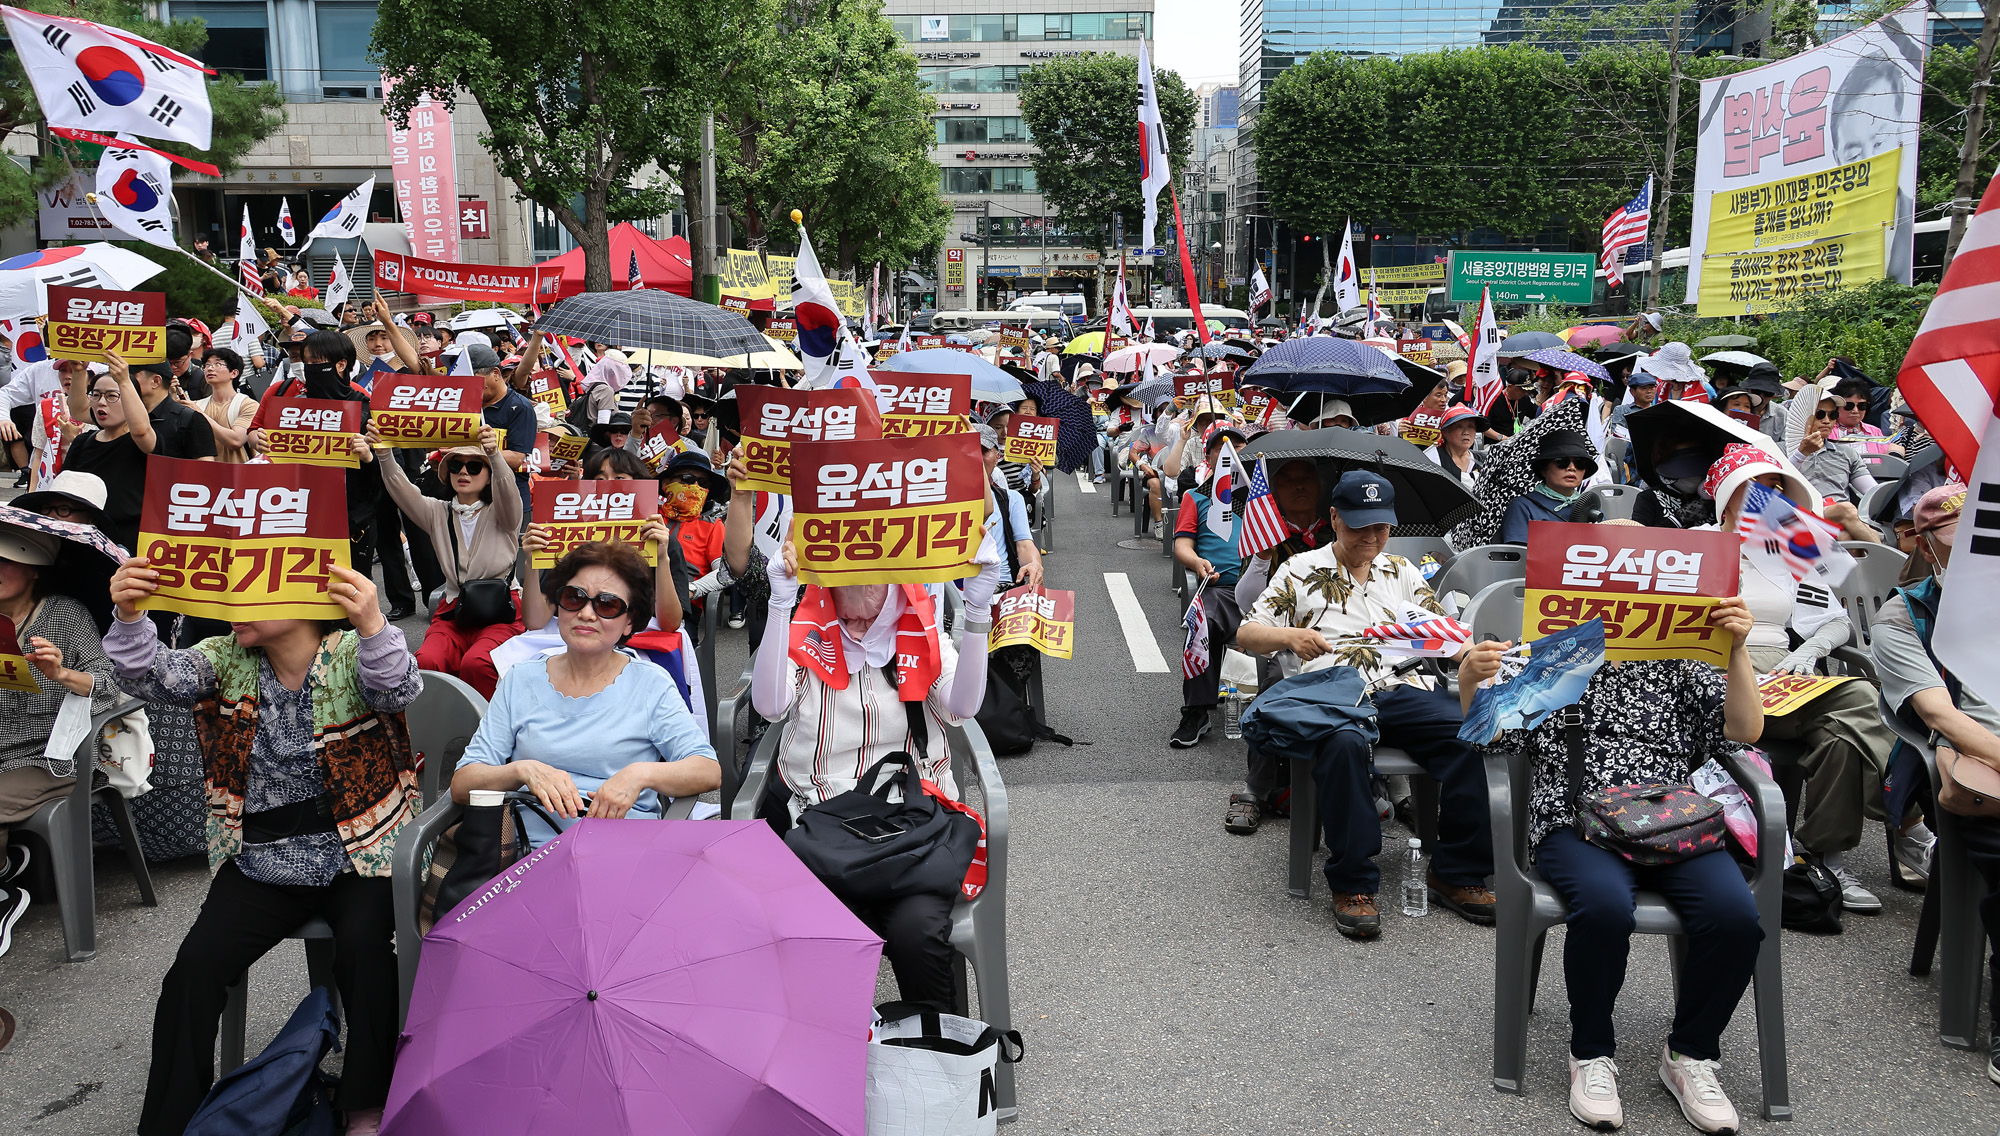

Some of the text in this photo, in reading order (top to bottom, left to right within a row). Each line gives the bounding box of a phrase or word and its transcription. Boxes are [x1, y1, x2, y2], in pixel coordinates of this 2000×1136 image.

[1729, 187, 1772, 215] 사법부가
[461, 208, 487, 233] 취
[1790, 200, 1834, 230] 입니까?
[1461, 261, 1588, 279] 서울중앙지방법원 등기국
[1775, 251, 1800, 273] 정치
[1800, 243, 1844, 271] 판사들!
[411, 265, 463, 285] YOON,
[467, 273, 521, 288] AGAIN
[1729, 278, 1773, 303] 지나가는
[1774, 275, 1798, 298] 개가
[1495, 291, 1519, 300] 140m
[66, 297, 145, 326] 윤석열
[55, 325, 159, 353] 영장기각
[771, 321, 793, 330] 윤석열
[1002, 328, 1024, 338] 윤석열
[1432, 329, 1443, 338] POLICE
[882, 341, 898, 350] 윤석
[922, 338, 941, 346] 윤석열
[1402, 342, 1428, 353] 윤석열
[388, 385, 464, 412] 윤석열
[877, 384, 953, 416] 윤석열
[1183, 378, 1223, 396] 윤석열
[1249, 395, 1271, 407] 윤석
[279, 407, 344, 432] 윤석열
[376, 413, 473, 440] 영장기각
[760, 403, 858, 442] 윤석열
[1017, 421, 1055, 442] 윤석열
[1406, 424, 1442, 441] 영장기
[1413, 413, 1441, 429] 윤석
[269, 431, 352, 457] 영장기각
[1008, 438, 1056, 459] 영장기각
[816, 457, 949, 509] 윤석열
[168, 482, 311, 537] 윤석열
[553, 492, 637, 521] 윤석열
[803, 509, 974, 563] 영장기각
[146, 540, 336, 594] 영장기각
[1561, 543, 1705, 594] 윤석열
[998, 593, 1058, 620] 윤석열
[1538, 594, 1723, 641] 영장기각
[990, 614, 1067, 646] 영장기각
[798, 645, 835, 675] AGAIN
[456, 840, 561, 923] Olivia Lauren
